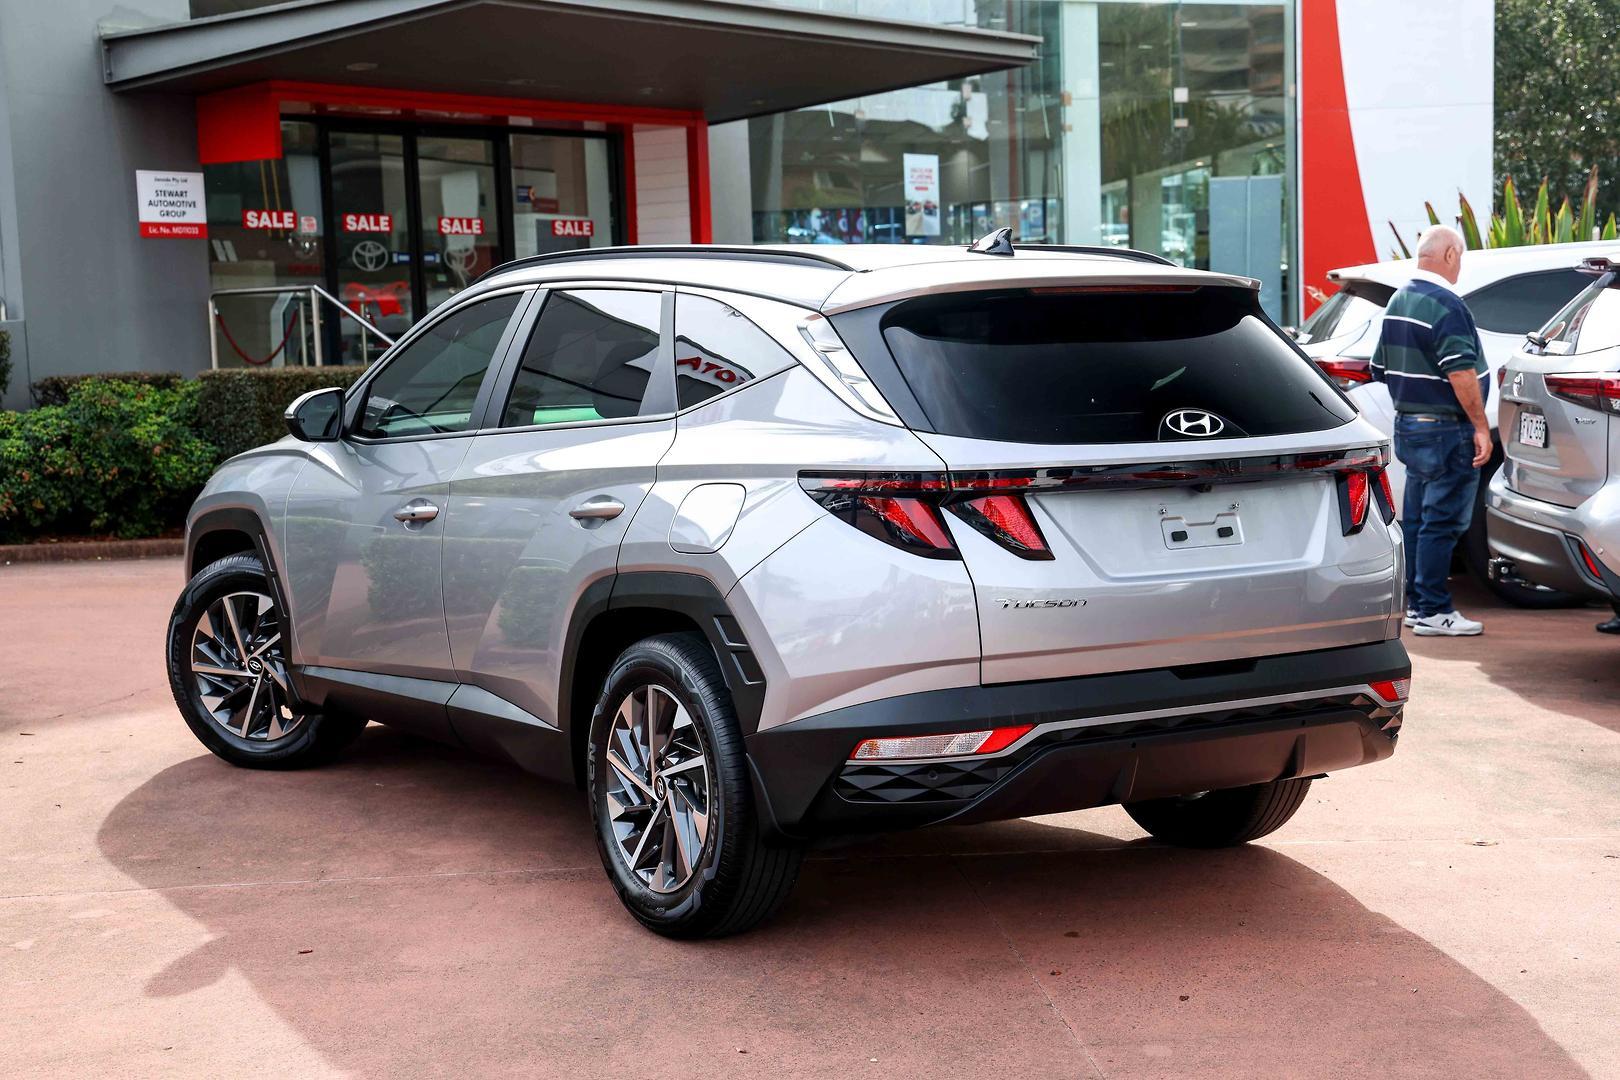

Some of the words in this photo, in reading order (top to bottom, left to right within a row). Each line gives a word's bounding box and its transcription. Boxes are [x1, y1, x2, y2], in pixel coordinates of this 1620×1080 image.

[148, 200, 197, 208] AUTOMOTIVE
[246, 211, 295, 229] SALE
[346, 215, 390, 231] SALE
[441, 218, 481, 234] SALE
[554, 221, 591, 236] SALE
